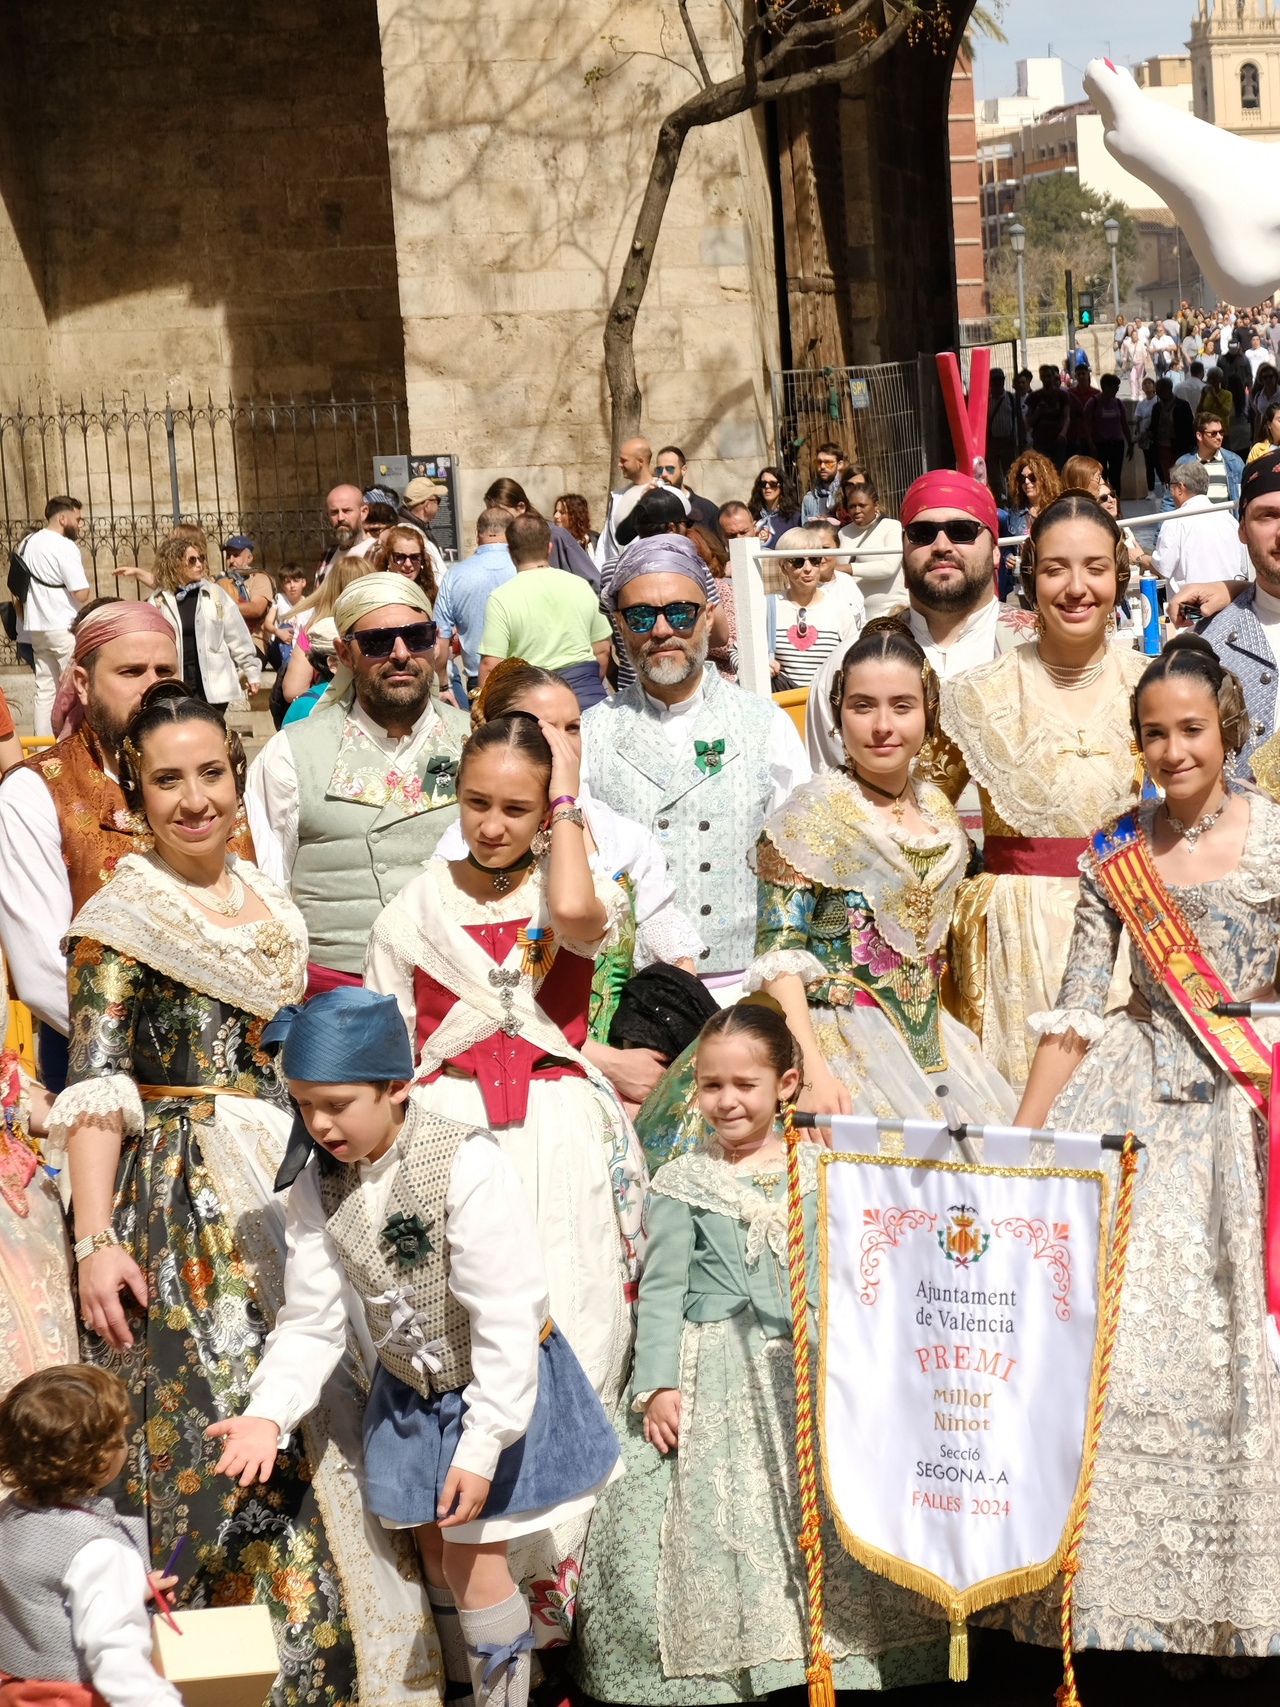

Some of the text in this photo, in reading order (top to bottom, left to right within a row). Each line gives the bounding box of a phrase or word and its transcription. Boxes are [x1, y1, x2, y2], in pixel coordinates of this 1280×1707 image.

[916, 1280, 1017, 1307] Ajuntament
[916, 1307, 1015, 1334] de València
[914, 1345, 1018, 1382] PREMI
[934, 1388, 992, 1410] Millor
[934, 1411, 990, 1432] Ninot
[940, 1445, 980, 1462] Secció
[916, 1461, 1009, 1486] SEGONA-A
[912, 1490, 1010, 1517] FALLES 2024
